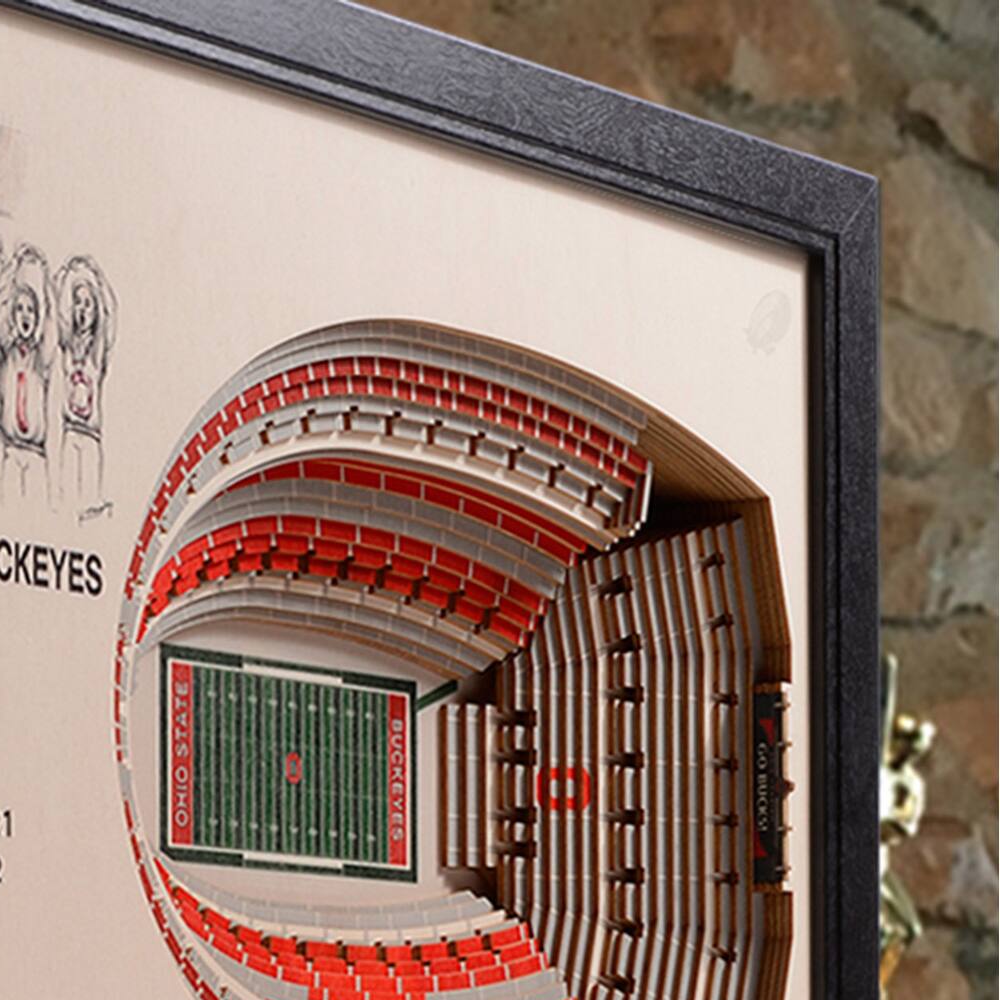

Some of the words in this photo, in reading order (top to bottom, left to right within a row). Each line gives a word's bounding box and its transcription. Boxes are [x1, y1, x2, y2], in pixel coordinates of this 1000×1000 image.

[174, 681, 189, 758] STATE
[174, 766, 189, 827] OHIO
[391, 718, 404, 841] BUCKEYES
